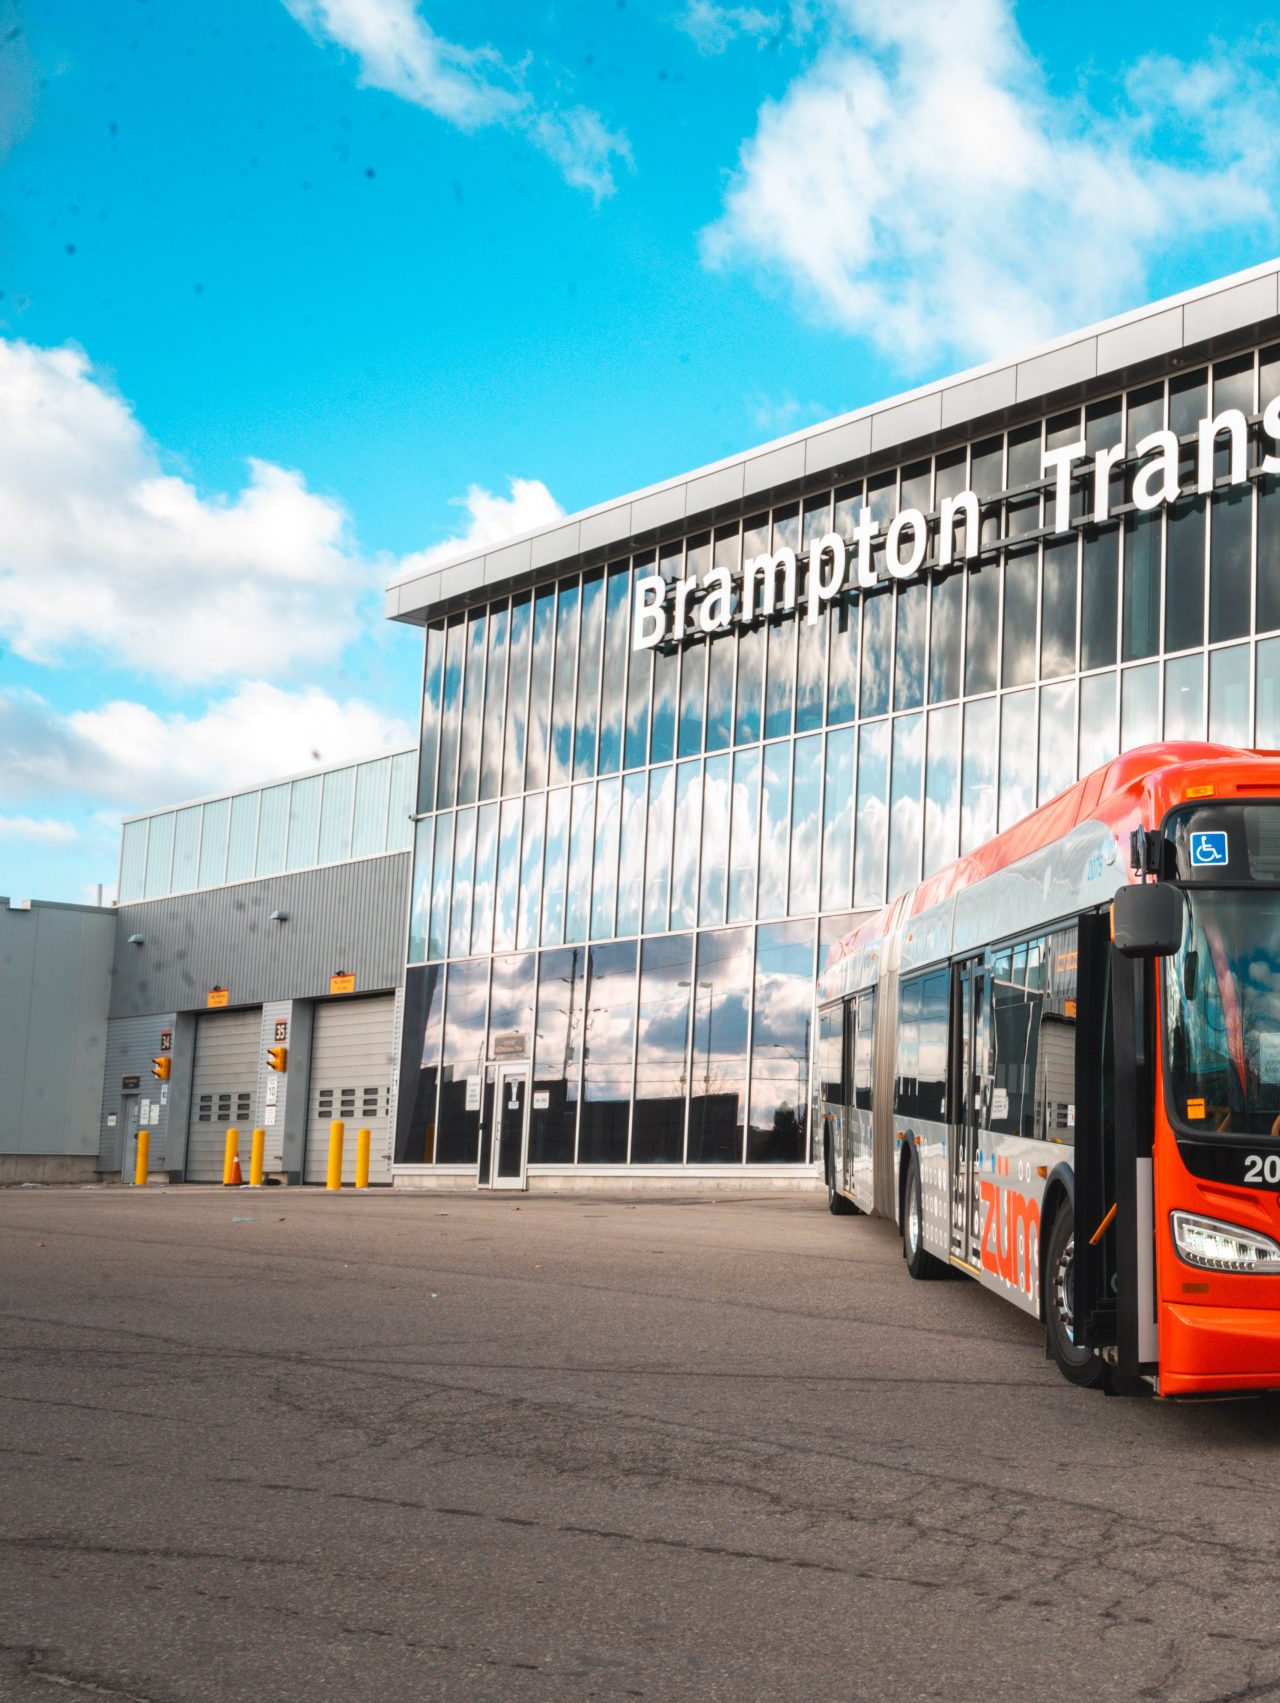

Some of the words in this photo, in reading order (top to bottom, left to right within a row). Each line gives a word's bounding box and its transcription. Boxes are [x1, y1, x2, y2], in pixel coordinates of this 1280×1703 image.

[633, 489, 981, 651] Brampton
[276, 1024, 285, 1040] 35
[162, 1035, 170, 1049] 34
